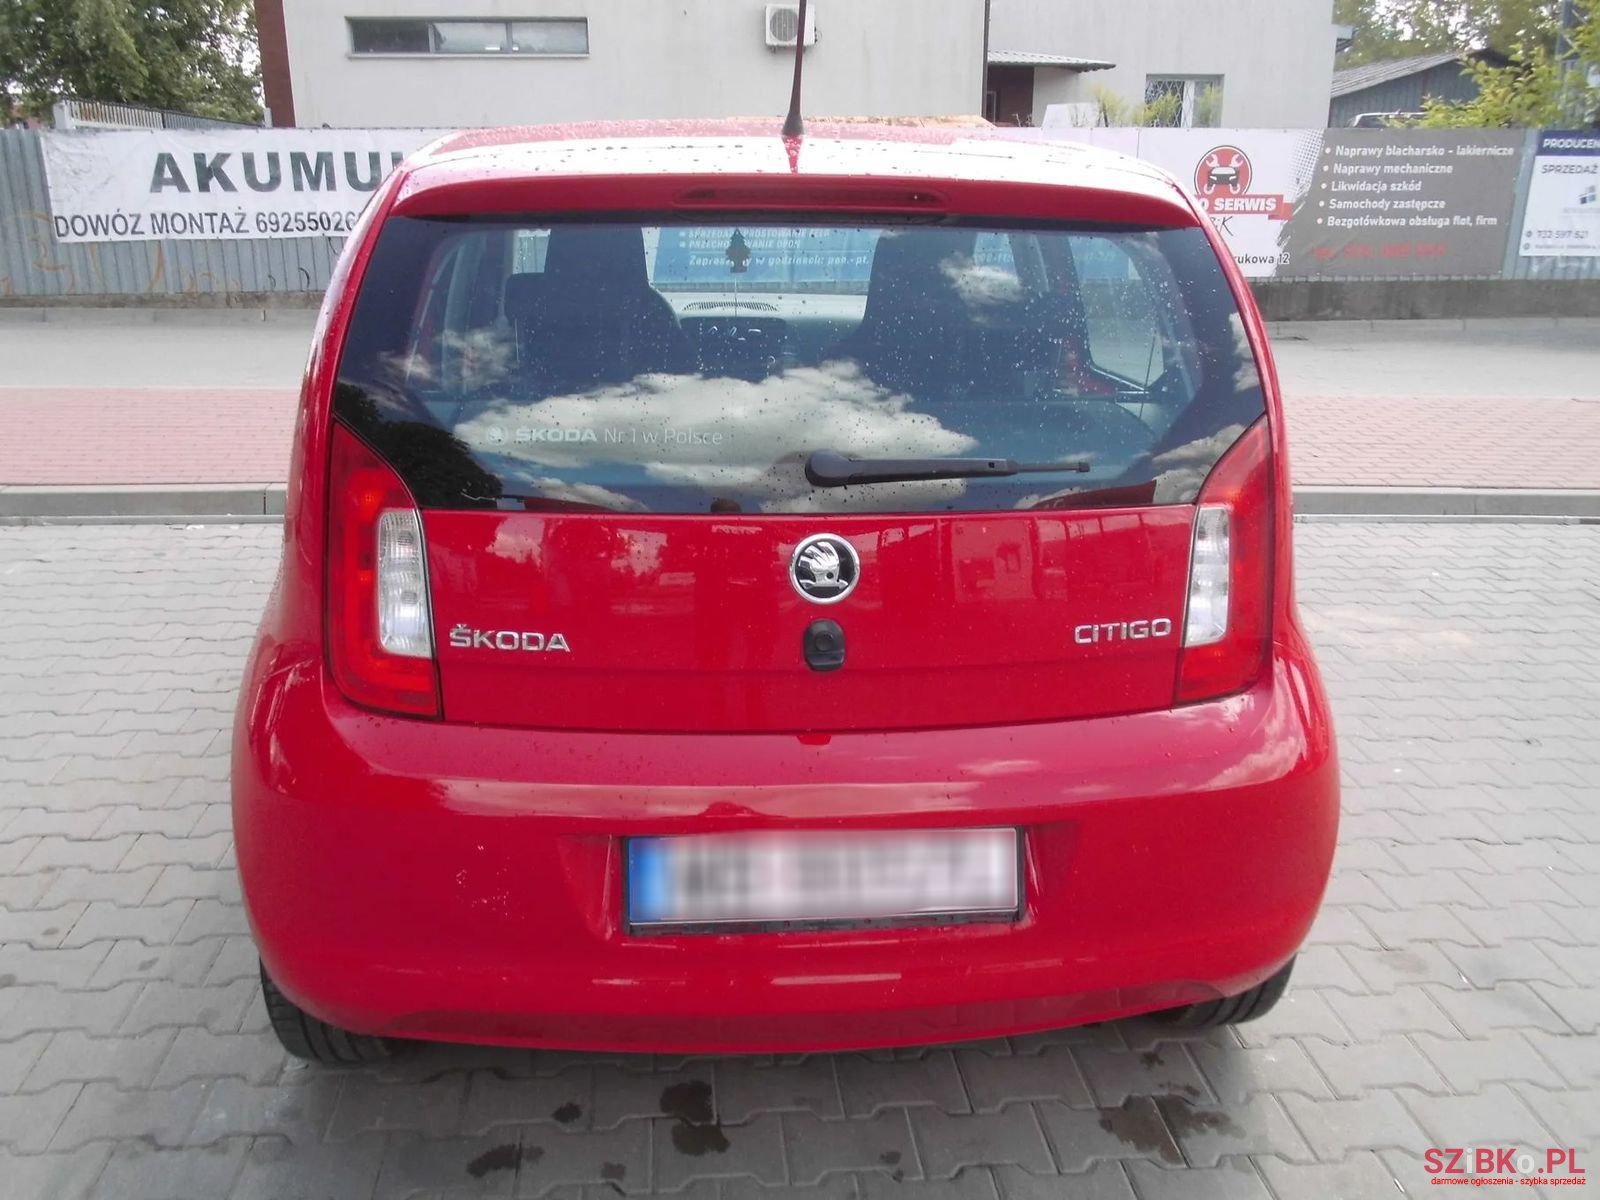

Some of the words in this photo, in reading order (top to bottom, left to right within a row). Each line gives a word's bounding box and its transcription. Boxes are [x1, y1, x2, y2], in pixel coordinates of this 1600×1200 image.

[1335, 145, 1383, 158] Naprawy
[1385, 145, 1445, 156] blacharsko
[1456, 145, 1515, 156] lakiernicze
[150, 151, 403, 193] AKUMU
[1333, 163, 1381, 176] Naprawy
[1383, 163, 1453, 174] mechaniczne
[1331, 181, 1387, 194] Likwidacja
[1390, 180, 1422, 191] szkód
[1213, 197, 1277, 212] SERWIS
[1329, 198, 1390, 211] Samochody
[1392, 199, 1446, 212] zastępcze
[54, 208, 145, 238] DOWÓZ
[150, 206, 250, 236] MONTAŻ
[255, 210, 360, 233] 69255026
[1327, 215, 1406, 228] Bezgotówkowa
[1408, 216, 1450, 228] obsługa
[1475, 215, 1498, 225] firm
[1278, 253, 1290, 264] 12
[515, 426, 598, 443] ŠKODA
[604, 427, 624, 443] Nr
[642, 432, 657, 444] w
[664, 427, 723, 446] Polsce
[449, 623, 571, 653] ŠKODA
